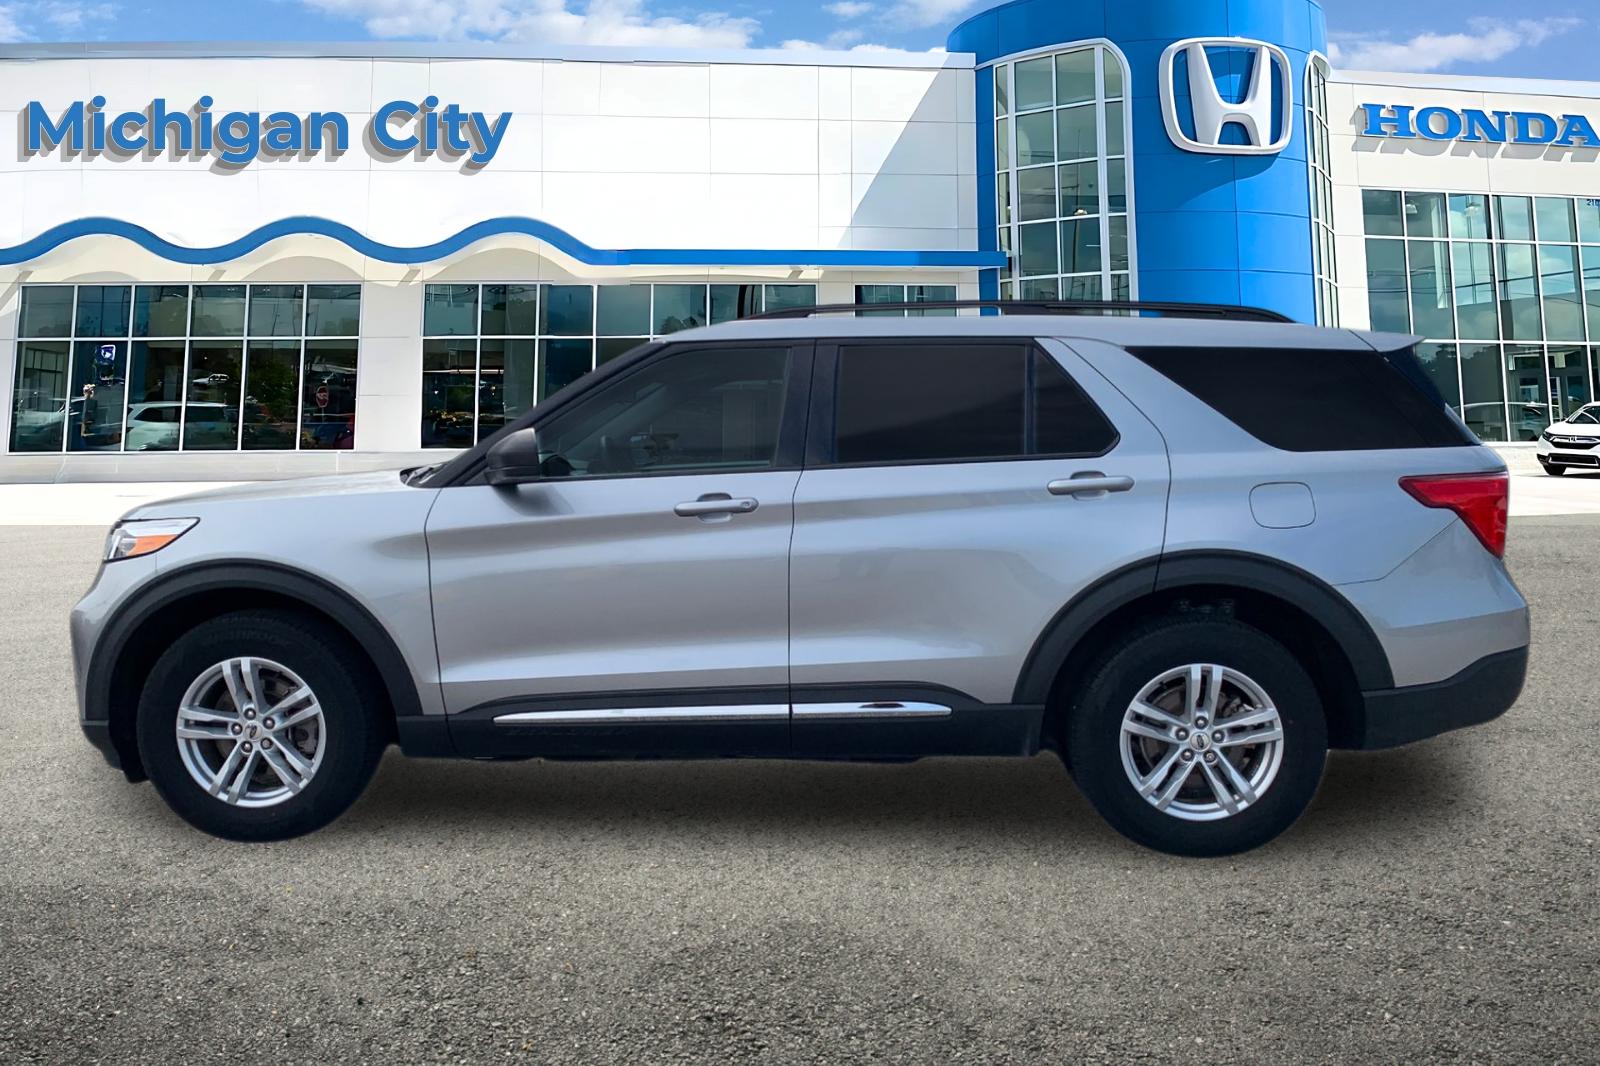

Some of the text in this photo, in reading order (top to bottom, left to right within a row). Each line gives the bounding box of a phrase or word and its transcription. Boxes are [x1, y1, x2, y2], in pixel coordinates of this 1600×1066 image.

[28, 95, 513, 164] Michigan City
[1361, 103, 1600, 147] HONDA
